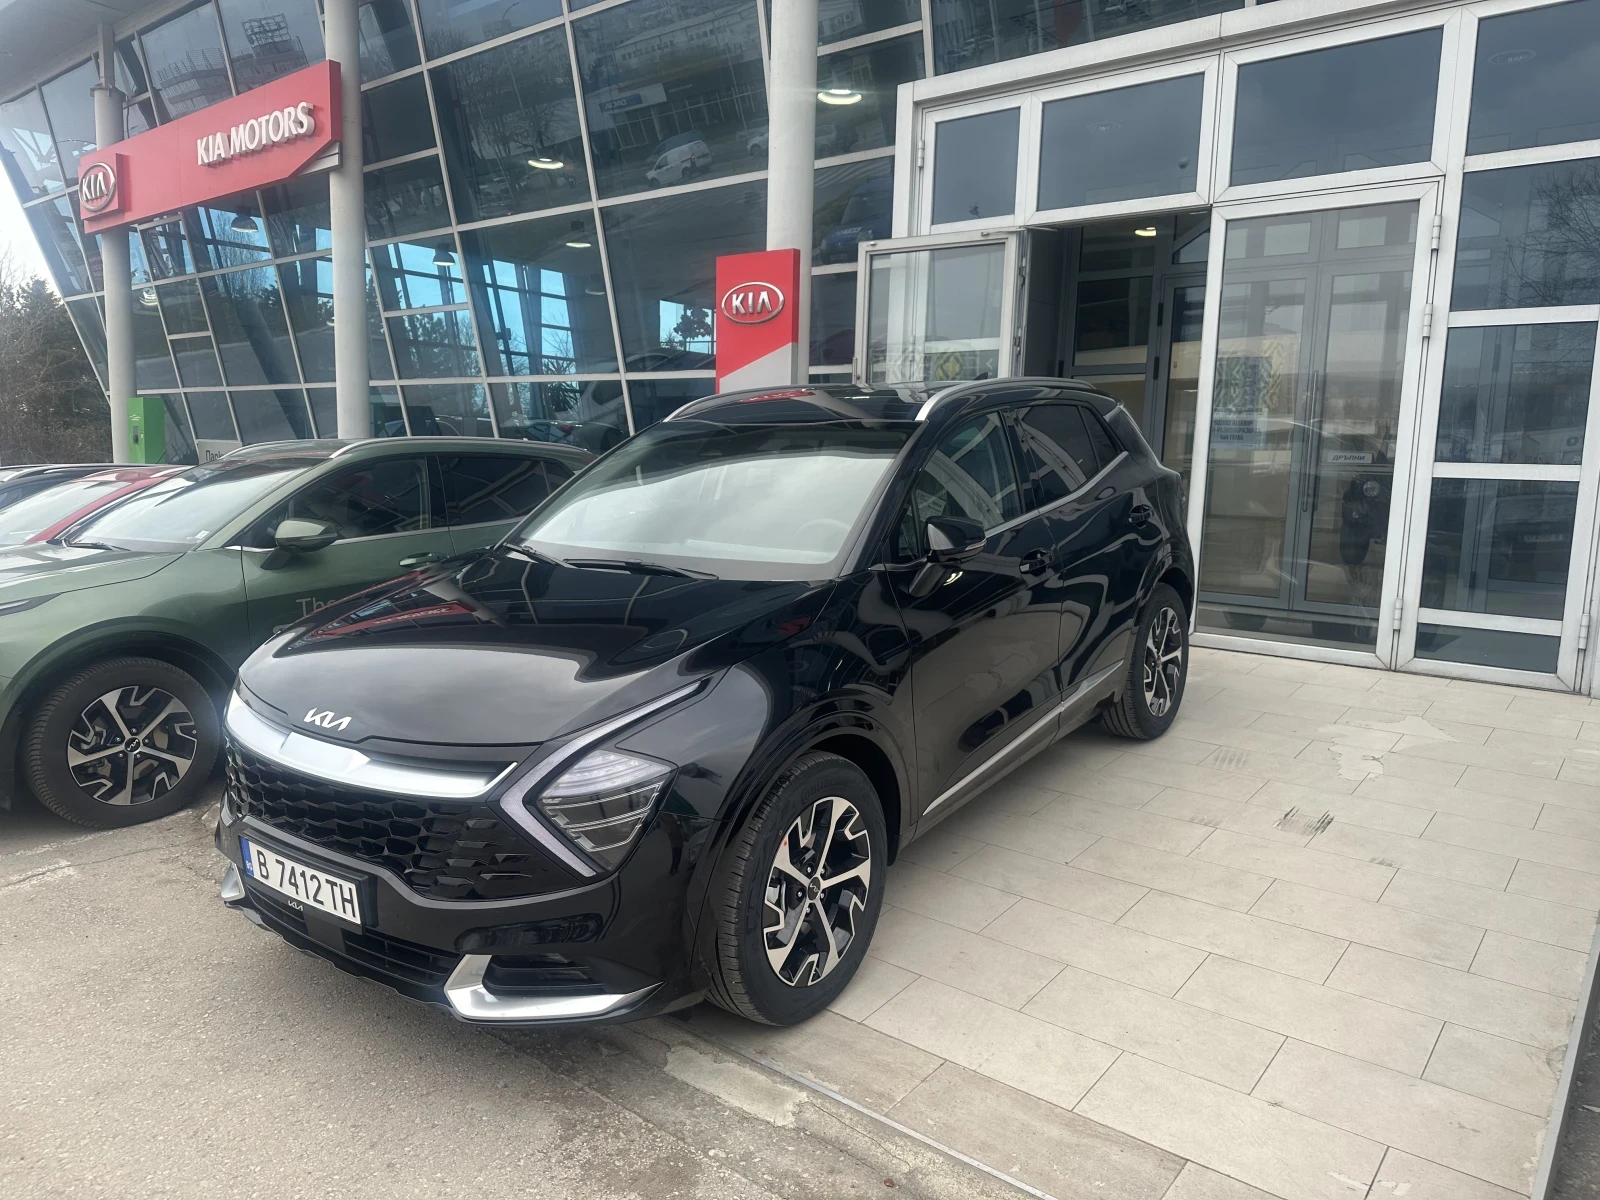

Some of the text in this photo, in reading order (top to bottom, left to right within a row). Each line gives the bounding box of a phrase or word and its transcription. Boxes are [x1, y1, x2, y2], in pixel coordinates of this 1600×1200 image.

[197, 101, 314, 166] KIA MOTORS
[82, 172, 108, 202] KIA
[732, 291, 772, 315] KIA
[303, 707, 352, 731] KIA
[257, 849, 357, 918] B 7412 TH
